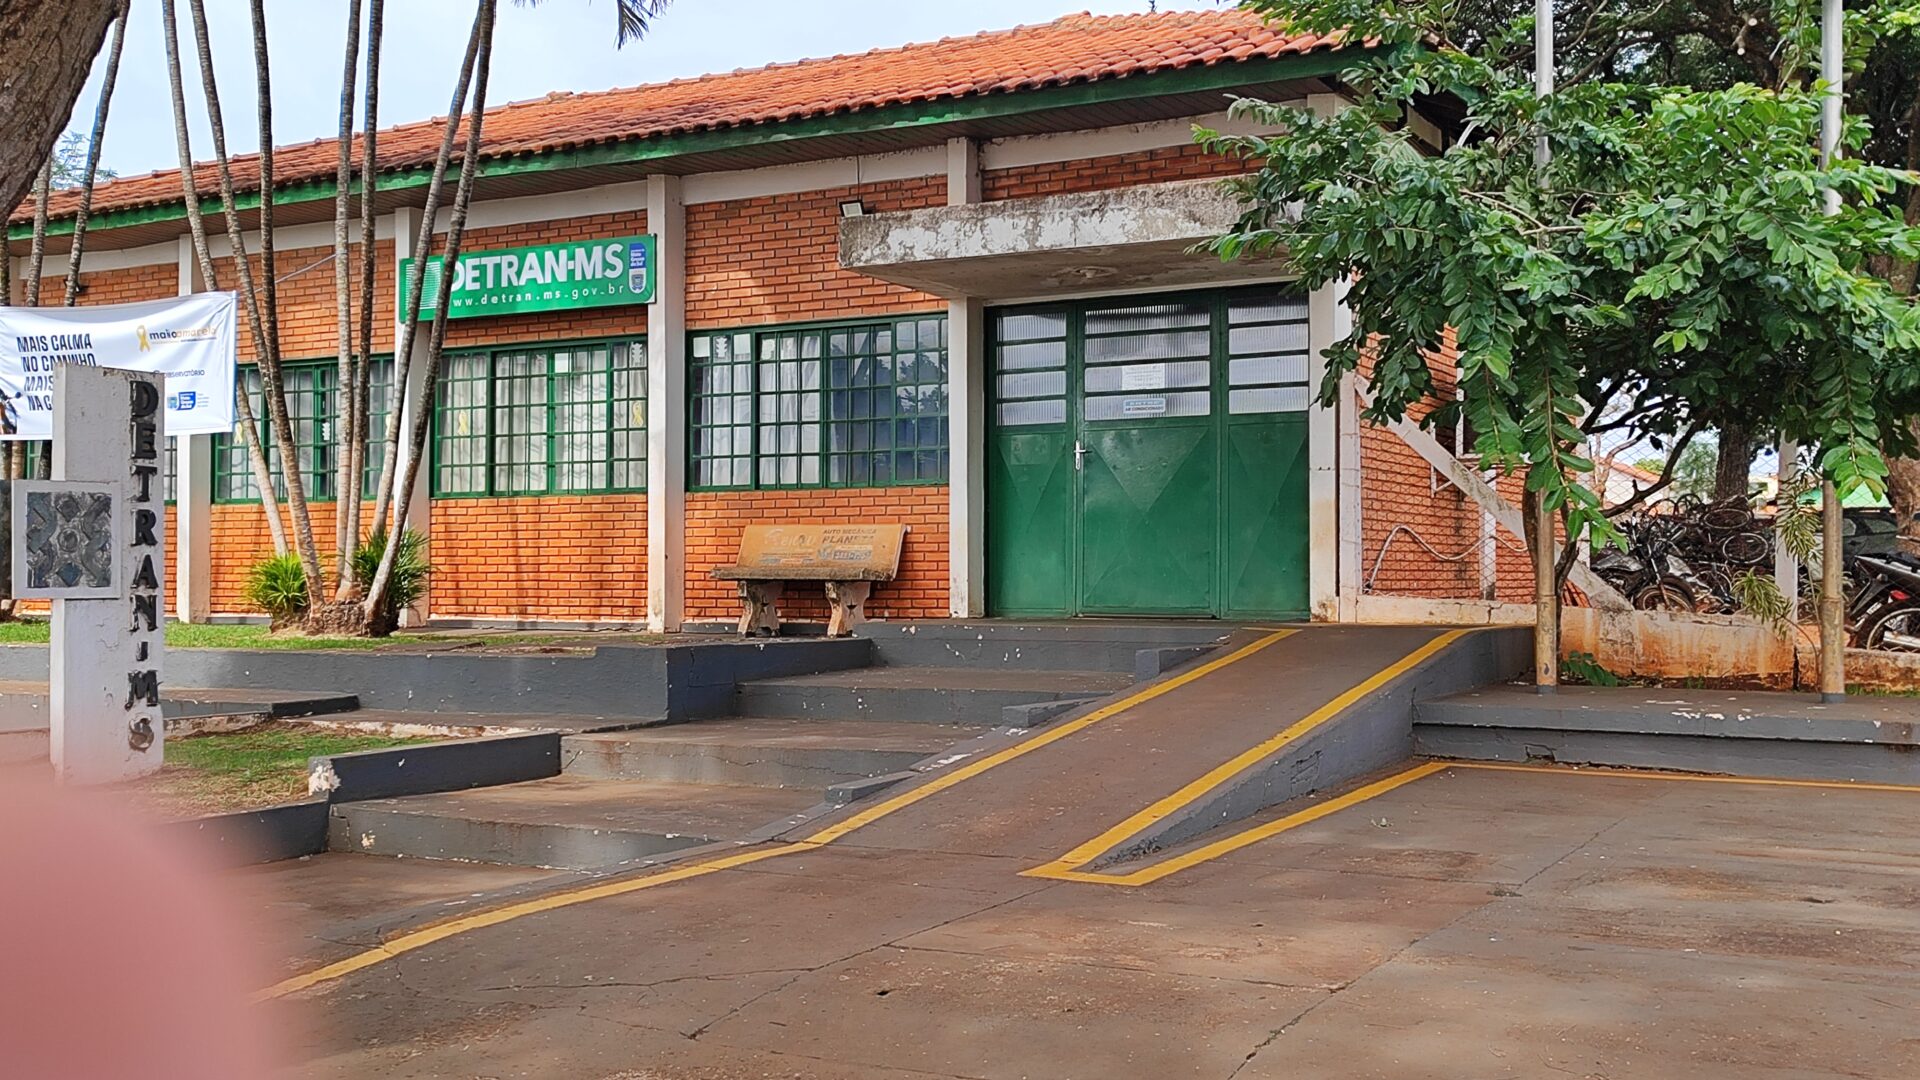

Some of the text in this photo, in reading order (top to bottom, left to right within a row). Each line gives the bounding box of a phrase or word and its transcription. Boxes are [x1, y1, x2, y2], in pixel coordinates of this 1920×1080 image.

[450, 243, 624, 293] DETRAN-MS
[452, 283, 624, 307] ww.detran.ms.gov.br
[16, 333, 93, 352] MAIS CALMA
[22, 355, 39, 372] NO
[27, 395, 44, 411] NA
